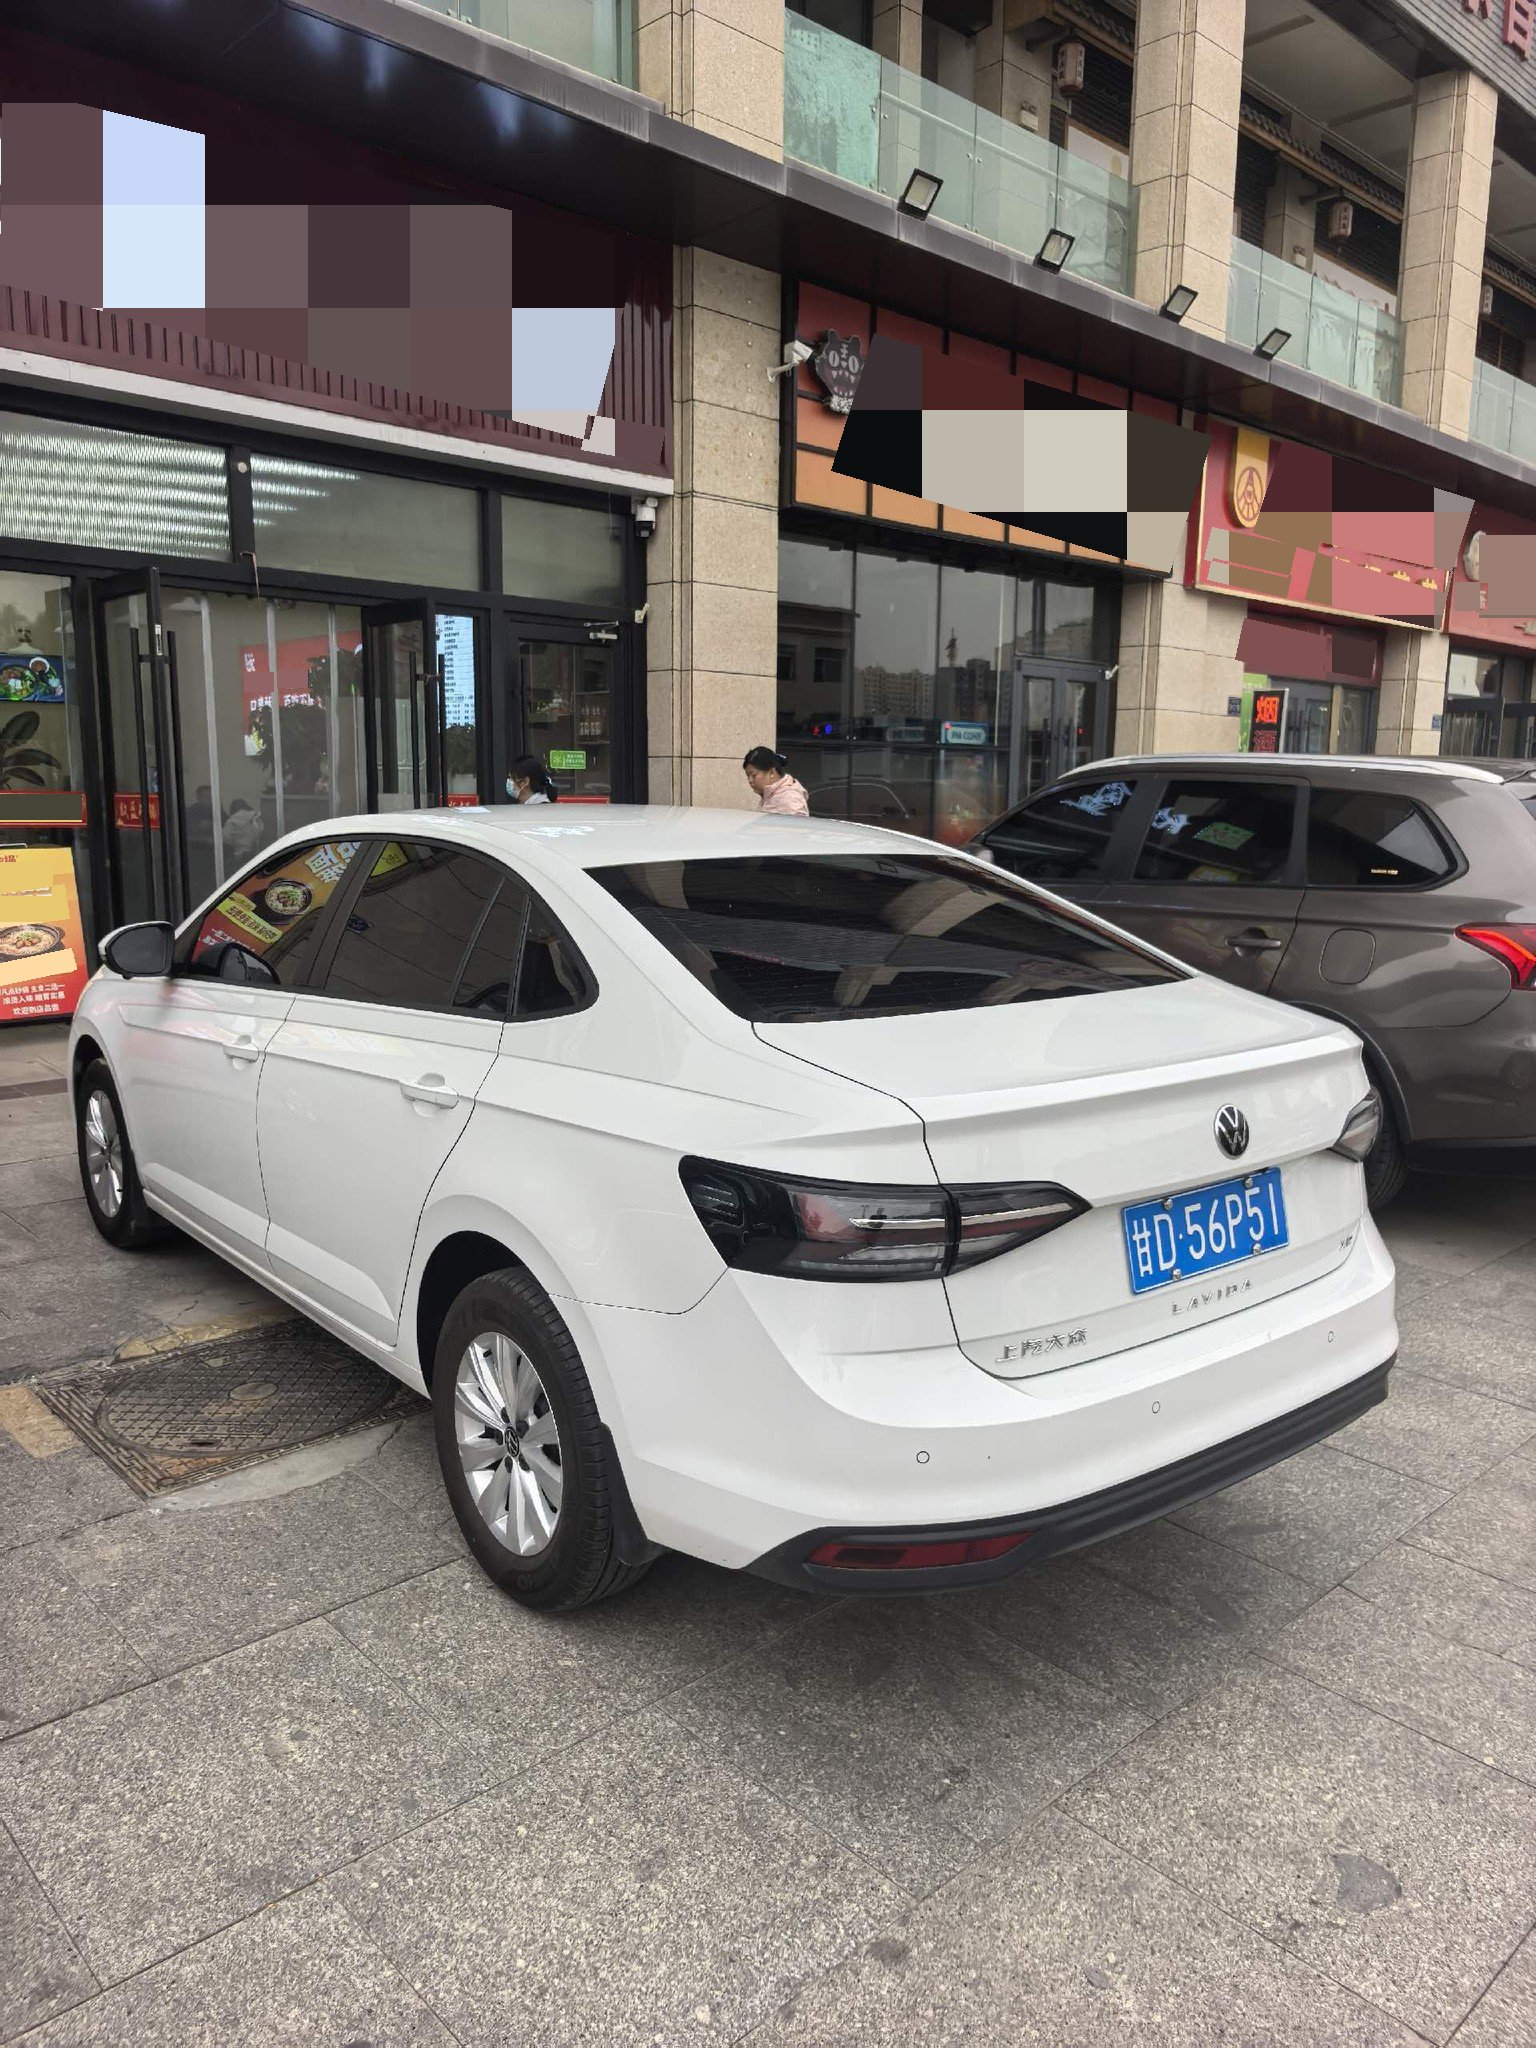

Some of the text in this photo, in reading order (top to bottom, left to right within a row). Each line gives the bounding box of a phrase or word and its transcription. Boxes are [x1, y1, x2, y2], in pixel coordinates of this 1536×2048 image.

[1172, 1279, 1251, 1316] LAVIDA
[995, 1328, 1087, 1363] 上汽大众
